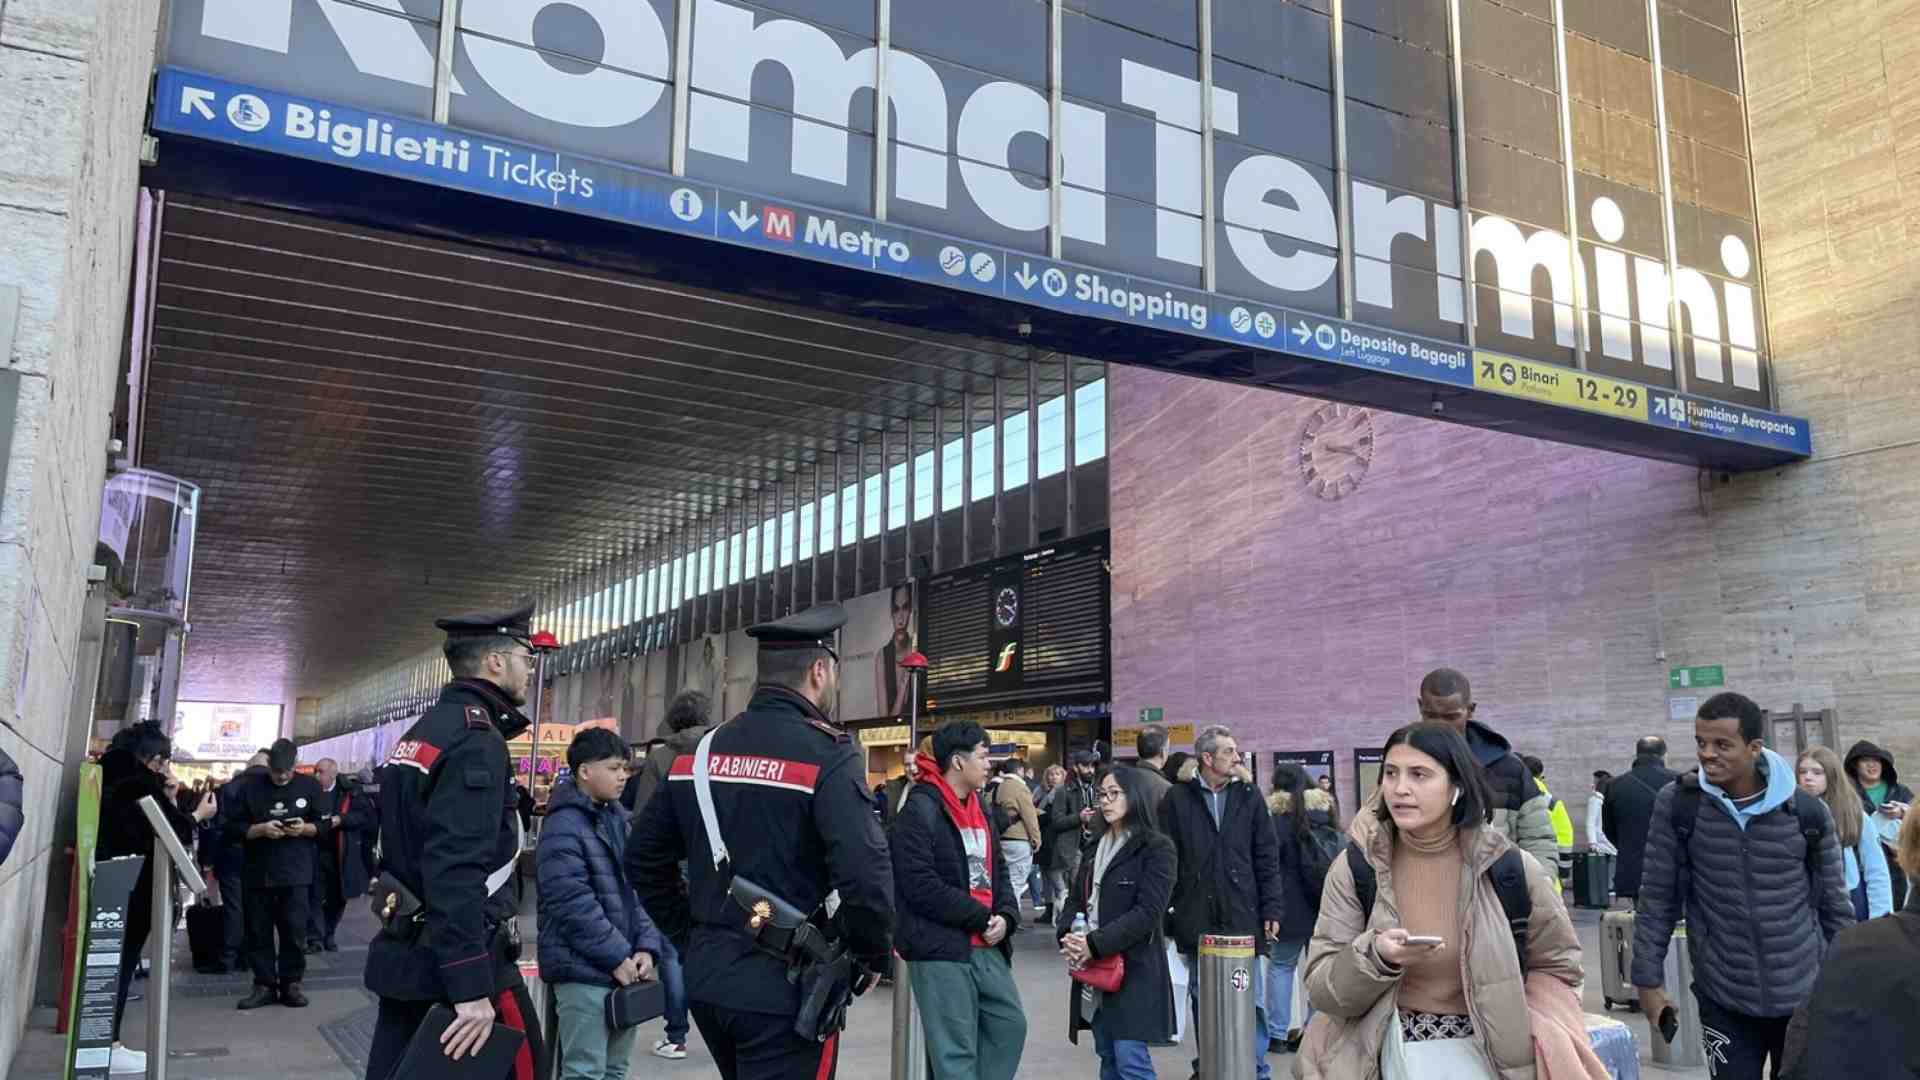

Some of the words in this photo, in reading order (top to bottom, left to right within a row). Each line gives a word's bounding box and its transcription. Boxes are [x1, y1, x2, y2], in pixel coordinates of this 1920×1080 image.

[199, 0, 1106, 246] oma
[285, 104, 470, 173] Biglietti
[482, 145, 594, 198] Tickets
[766, 212, 792, 238] M
[804, 215, 910, 263] Metro
[1075, 273, 1208, 330] Shopping
[1341, 328, 1408, 356] Deposito
[1410, 342, 1466, 369] Bagagli
[1520, 366, 1560, 387] Binari
[692, 756, 785, 781] RABINIERI
